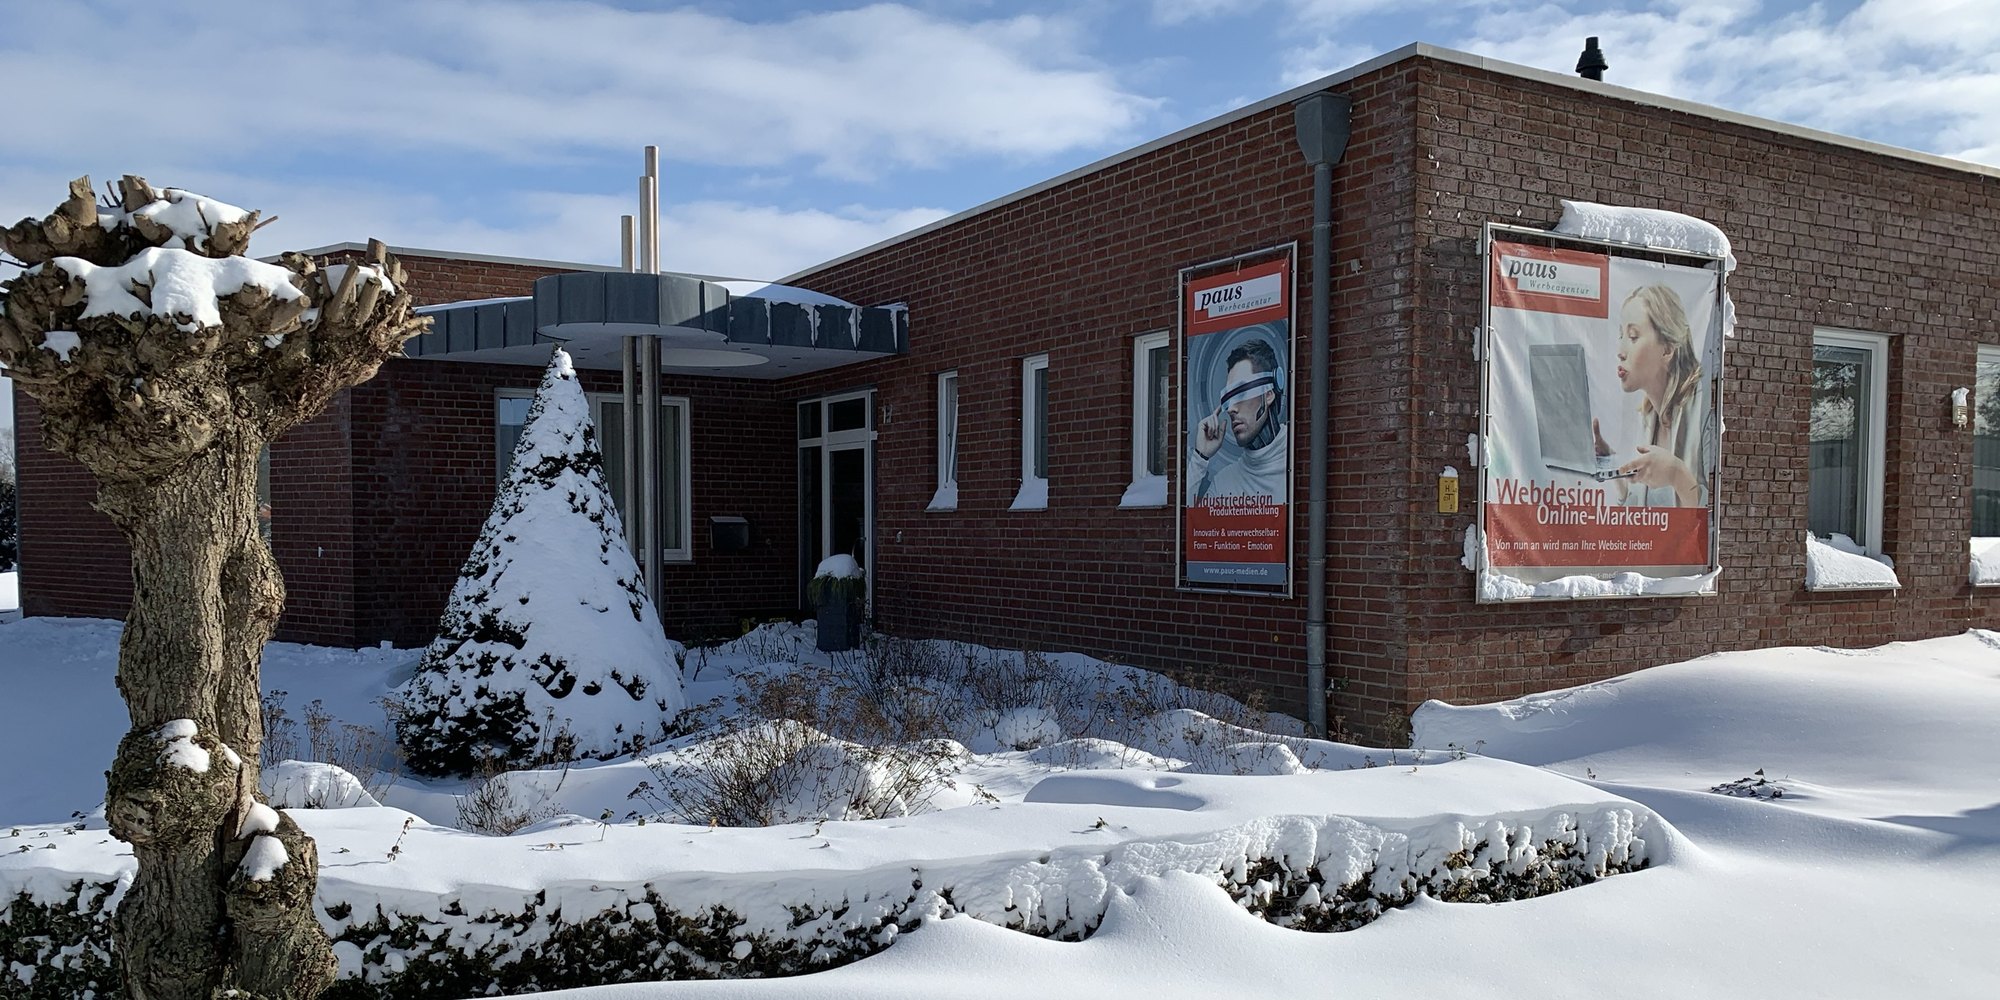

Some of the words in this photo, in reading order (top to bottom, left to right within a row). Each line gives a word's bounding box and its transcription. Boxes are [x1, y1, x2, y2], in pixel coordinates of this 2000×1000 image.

[1509, 259, 1558, 280] paus
[1529, 279, 1590, 295] Werbeagentur
[1200, 285, 1243, 311] paus
[1218, 296, 1272, 313] Werbeagentur
[1496, 478, 1605, 506] Webdesign
[1209, 504, 1279, 518] Produktentwicklung
[1536, 503, 1669, 531] Online-Marketing
[1193, 528, 1219, 537] Innovativ
[1220, 528, 1226, 537] &
[1227, 528, 1280, 537] unverwechselbar:
[1193, 541, 1207, 550] Form
[1214, 541, 1240, 550] Funktion
[1247, 541, 1273, 550] Emotion
[1495, 539, 1510, 550] Von
[1513, 541, 1528, 550] nun
[1530, 541, 1540, 550] an
[1543, 539, 1559, 550] wird
[1562, 541, 1579, 550] man
[1581, 539, 1596, 550] Ihre
[1599, 540, 1627, 550] Website
[1629, 539, 1653, 550] lieben!
[1203, 567, 1268, 576] www.paus-medien.de
